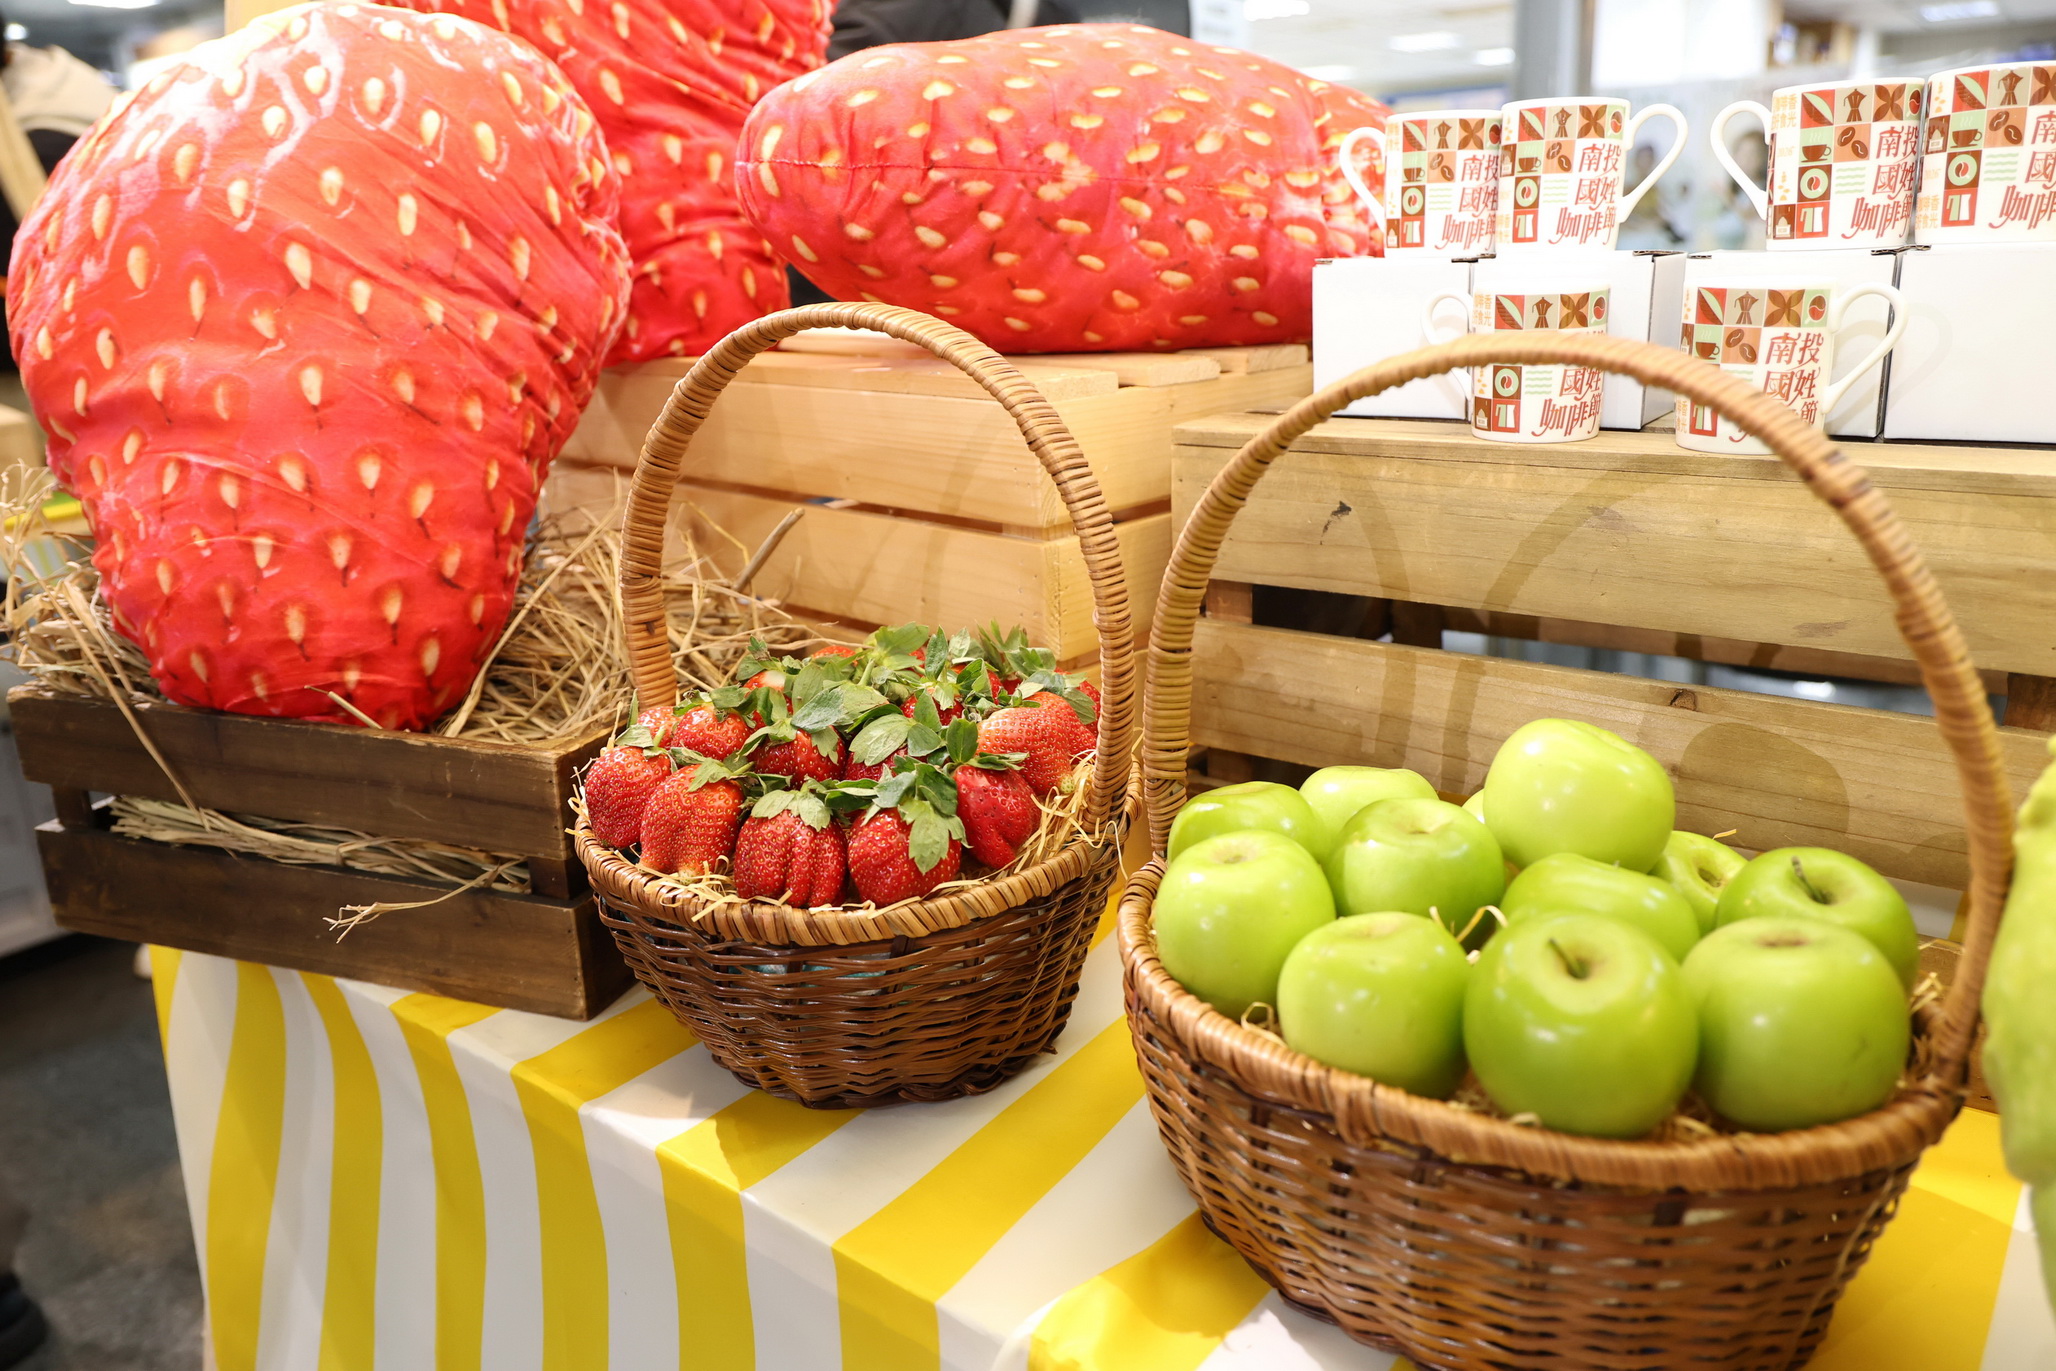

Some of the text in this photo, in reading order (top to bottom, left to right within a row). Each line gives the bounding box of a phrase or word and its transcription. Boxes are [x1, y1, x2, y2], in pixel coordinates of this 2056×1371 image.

[1578, 143, 1621, 174] 南投
[1876, 126, 1919, 161] 南投
[1461, 154, 1499, 182] 南投
[1872, 162, 1915, 200] 國姓
[1459, 185, 1498, 217] 國姓
[1575, 176, 1619, 210] 國姓
[1434, 213, 1497, 251] 咖啡節
[1548, 206, 1616, 245] 咖啡節
[1841, 194, 1913, 239] 咖啡節
[1765, 332, 1824, 368] 南投
[1559, 367, 1601, 400] 國姓
[1763, 367, 1820, 406] 國姓
[1531, 394, 1601, 436] 咖啡節
